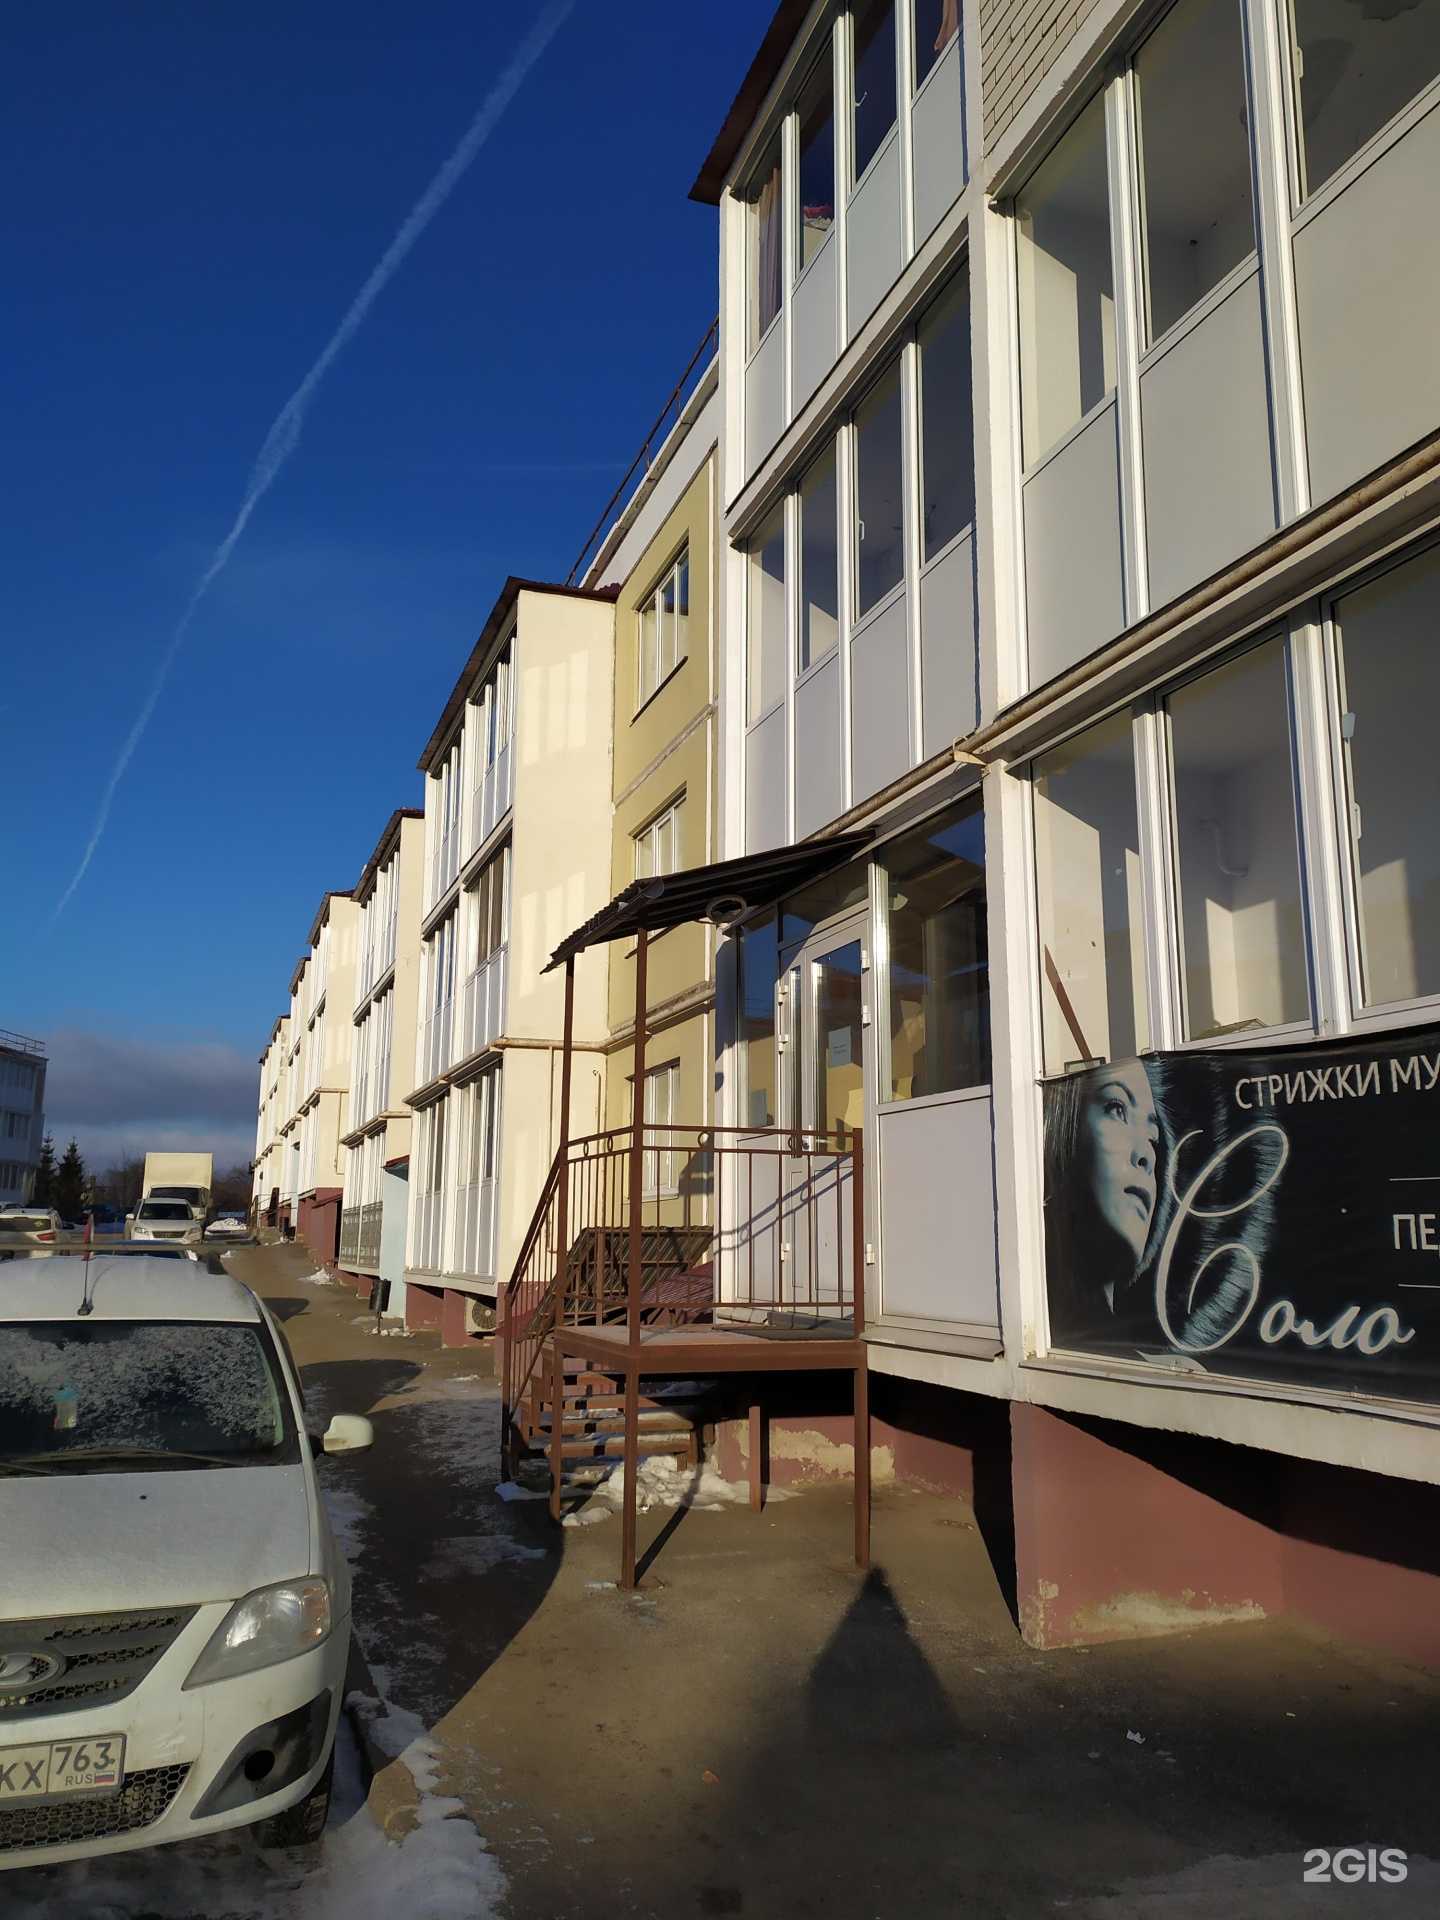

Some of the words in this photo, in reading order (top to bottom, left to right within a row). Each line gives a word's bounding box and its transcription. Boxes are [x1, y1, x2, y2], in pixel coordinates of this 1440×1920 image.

[1235, 1061, 1380, 1109] СТРИЖКИ
[1390, 1053, 1440, 1091] МУ
[1156, 1125, 1415, 1355] Соло
[55, 1742, 112, 1775] 763
[65, 1774, 93, 1786] RUS
